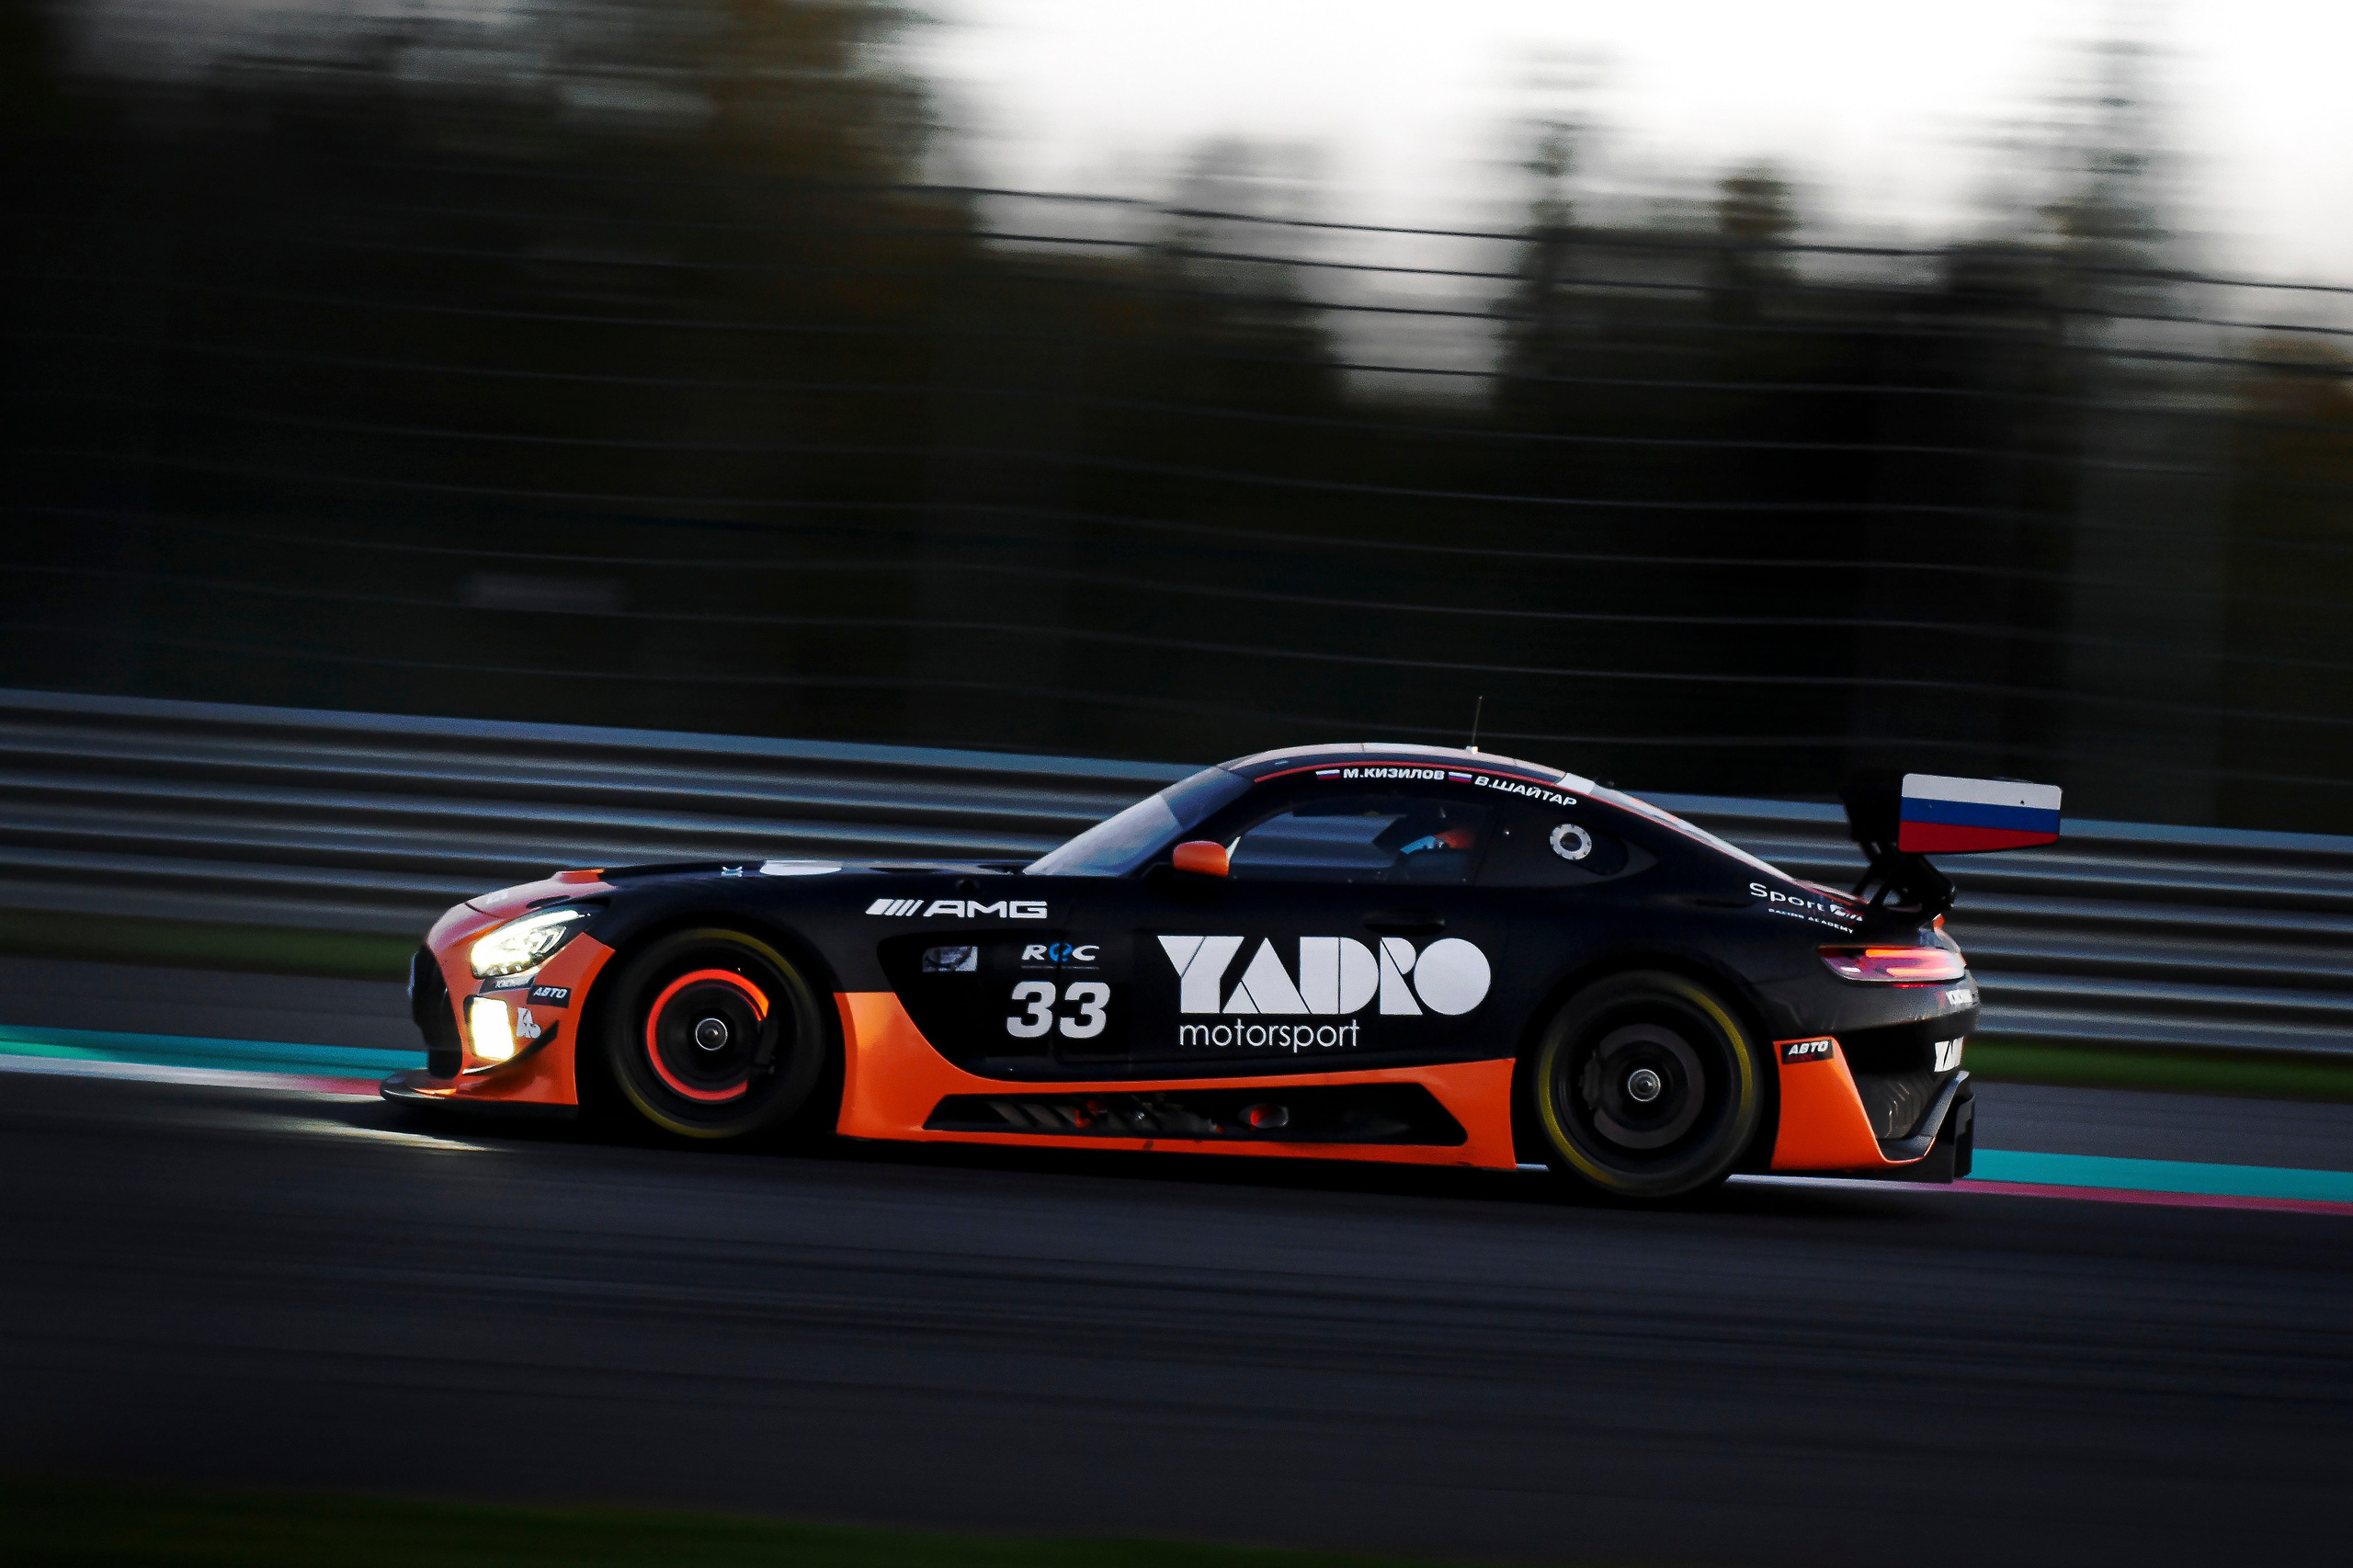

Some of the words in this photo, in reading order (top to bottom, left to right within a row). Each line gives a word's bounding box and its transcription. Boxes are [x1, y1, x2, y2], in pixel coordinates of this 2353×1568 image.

[1343, 768, 1445, 780] М.КИЗИЛОВ
[1474, 776, 1577, 807] В.ШАЙТАР
[923, 900, 1048, 919] AMG
[1749, 882, 1825, 912] Sport
[1157, 936, 1491, 1016] YADRO
[1006, 981, 1110, 1039] 33
[1179, 1018, 1360, 1053] motorsport
